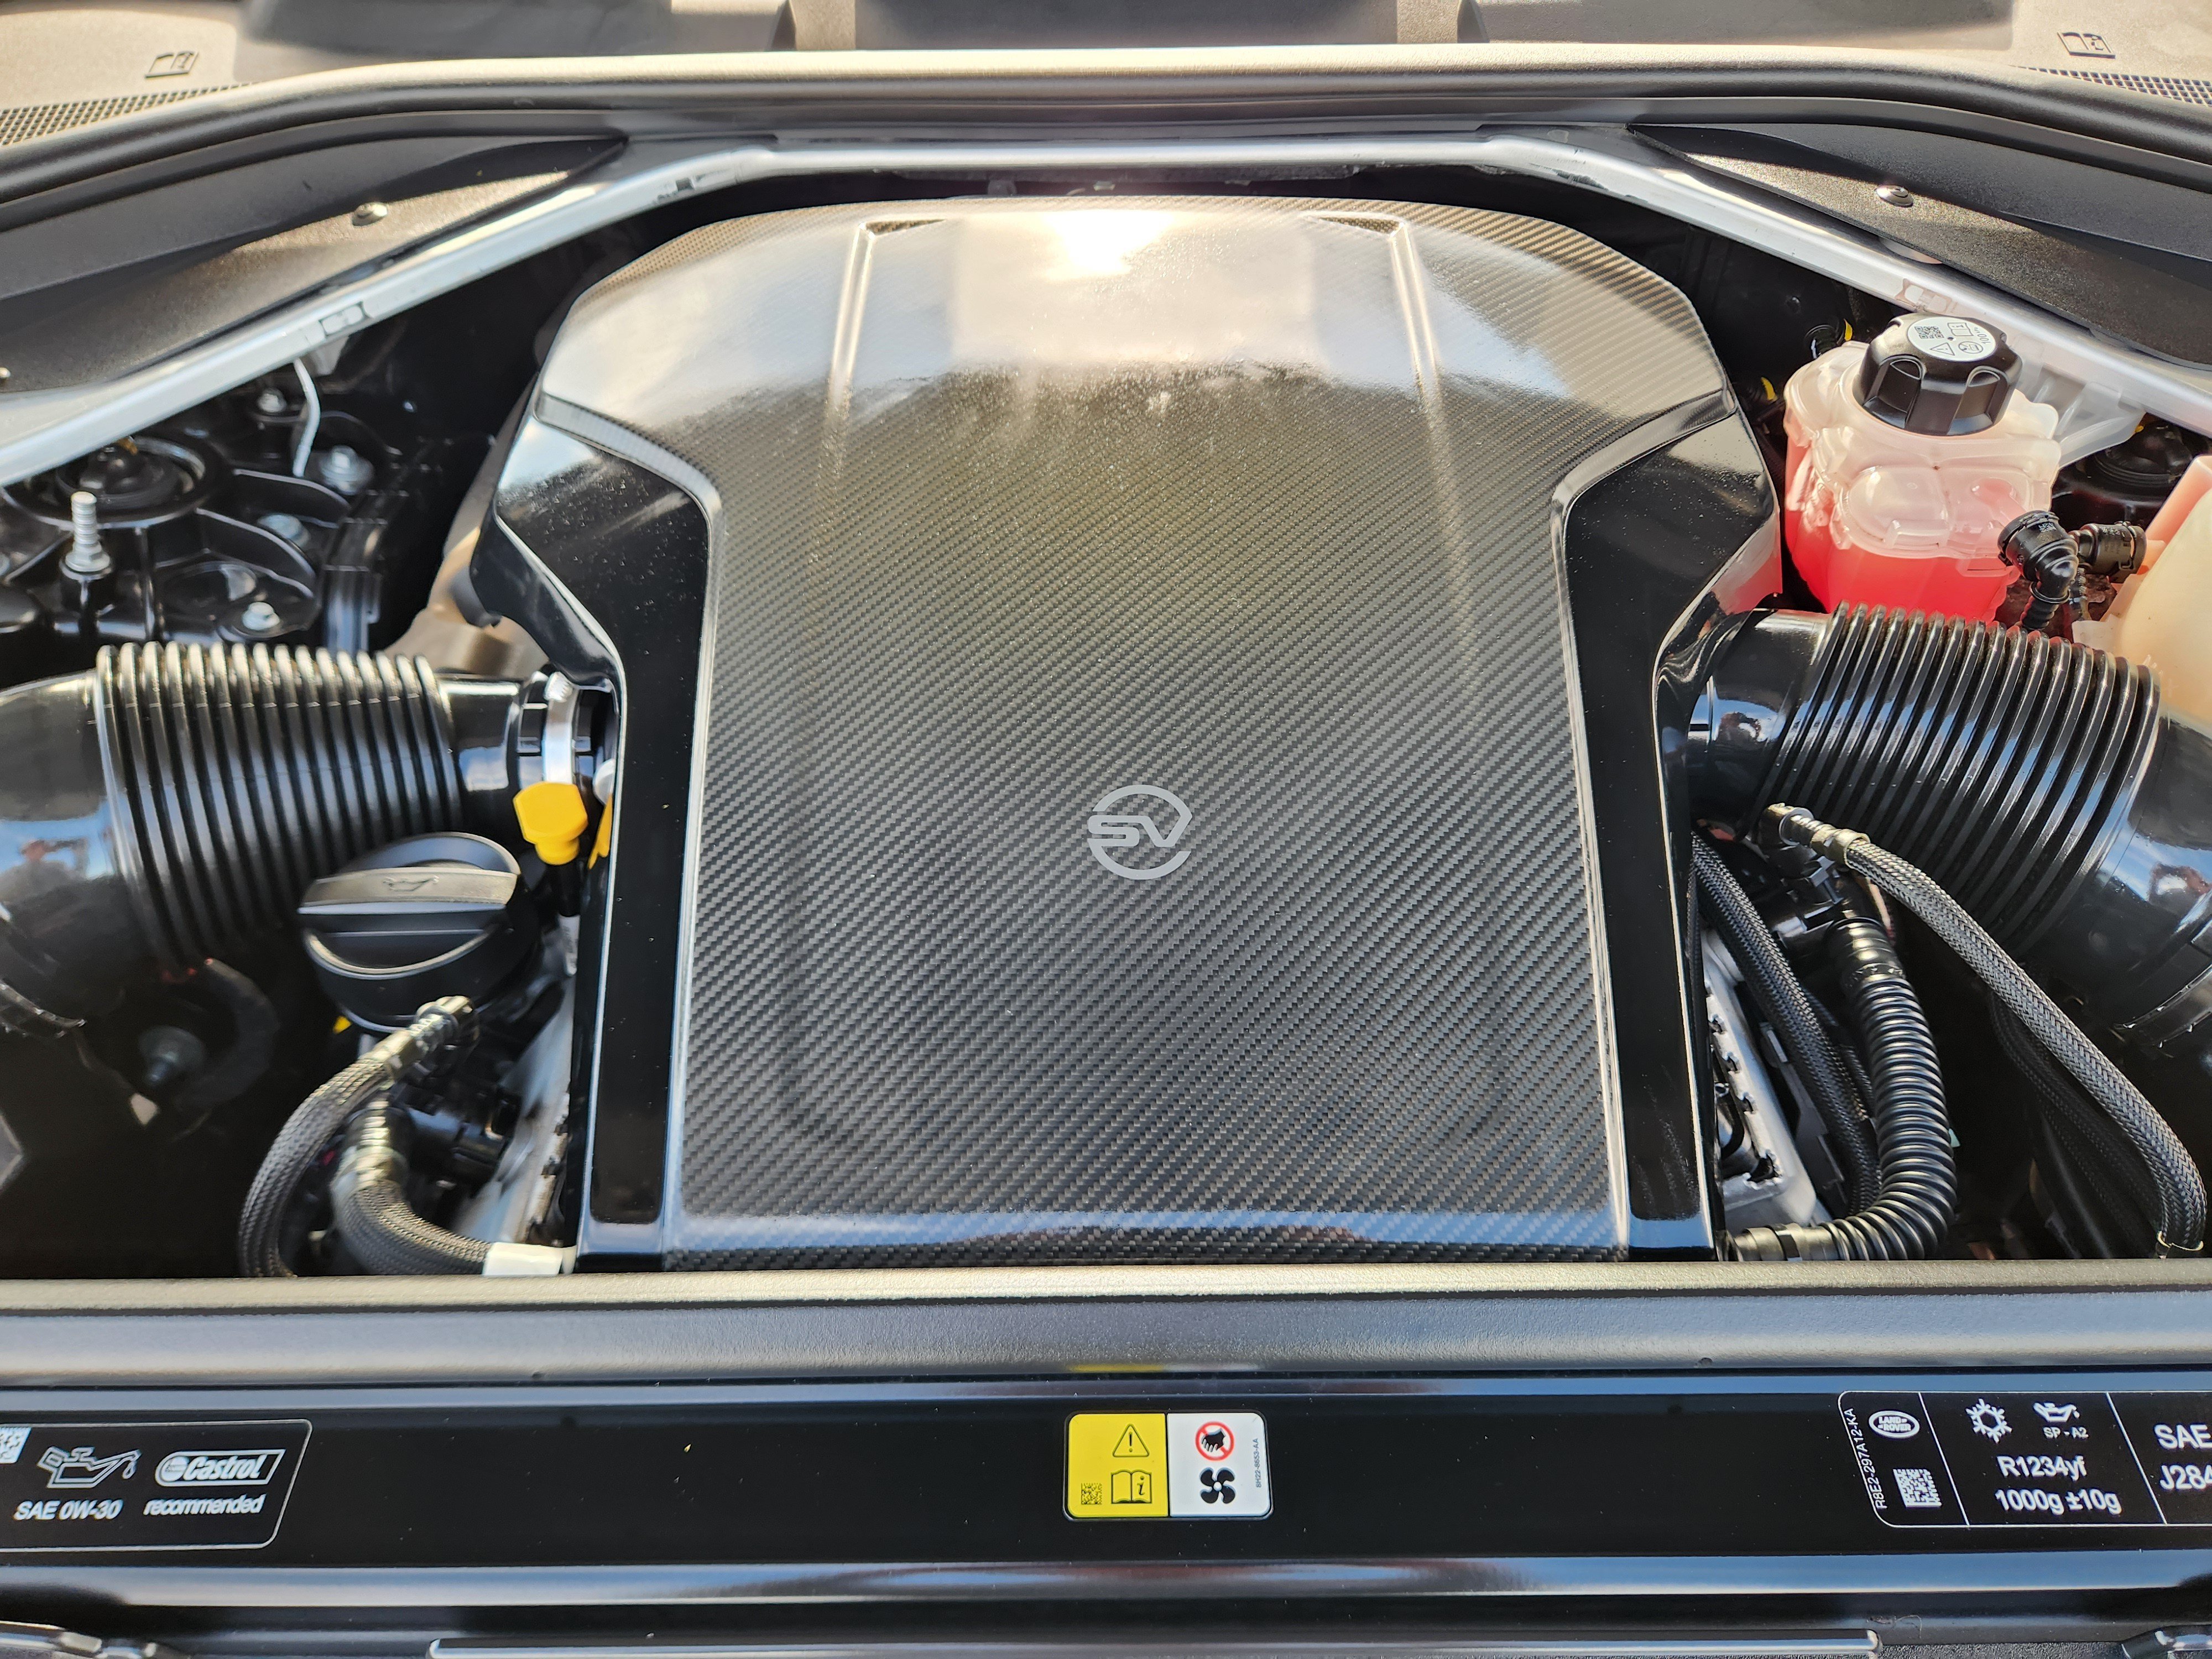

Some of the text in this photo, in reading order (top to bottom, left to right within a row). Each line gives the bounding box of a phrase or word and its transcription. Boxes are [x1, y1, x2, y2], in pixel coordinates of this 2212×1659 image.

[1977, 333, 1991, 344] 100
[1883, 1423, 1911, 1432] ROVER
[2043, 1426, 2060, 1438] SP
[2072, 1426, 2089, 1438] A2
[2154, 1424, 2212, 1449] SAE
[182, 1454, 268, 1481] Castrol
[1844, 1408, 1887, 1510] R8E2-297A12-KA
[1996, 1455, 2086, 1481] R1234yf
[13, 1499, 124, 1521] SAE 0W-30
[144, 1493, 267, 1516] recommended
[1995, 1489, 2122, 1515] 1000g ±10g
